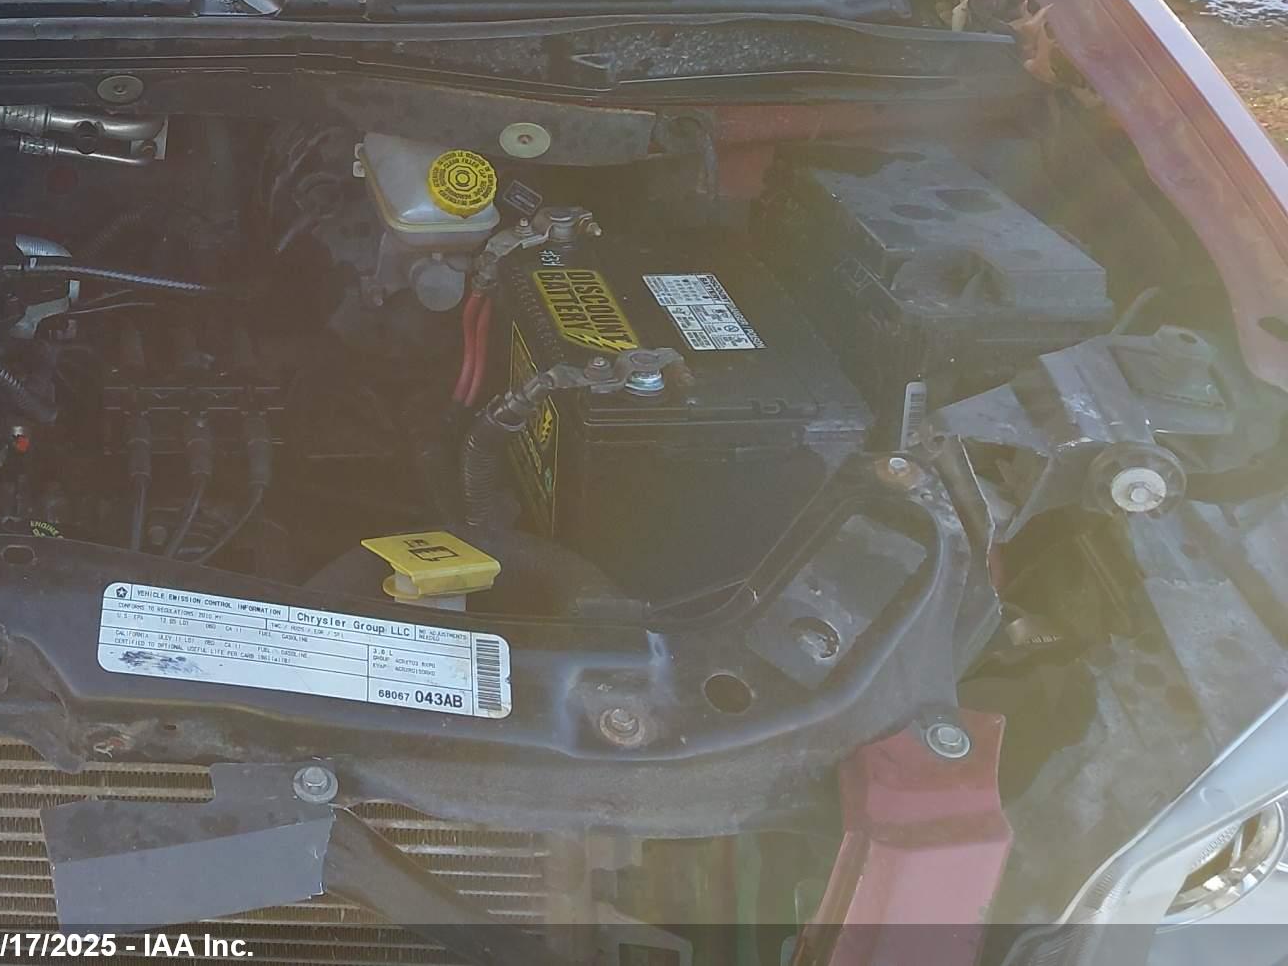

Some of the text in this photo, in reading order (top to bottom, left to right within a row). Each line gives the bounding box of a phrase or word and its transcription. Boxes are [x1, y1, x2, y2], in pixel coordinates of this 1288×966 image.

[536, 271, 595, 331] BATTERY
[566, 271, 634, 343] DISCOUNT
[118, 602, 145, 611] CONFORMS
[136, 590, 282, 616] VEHICLE EMISSION CONTROL INFORMATION
[297, 612, 410, 637] Chrysler Group LLC
[114, 638, 146, 646] CERTIFIED
[148, 640, 156, 648] TO
[158, 642, 184, 651] OPTIONAL
[378, 688, 464, 708] 68067 043AB
